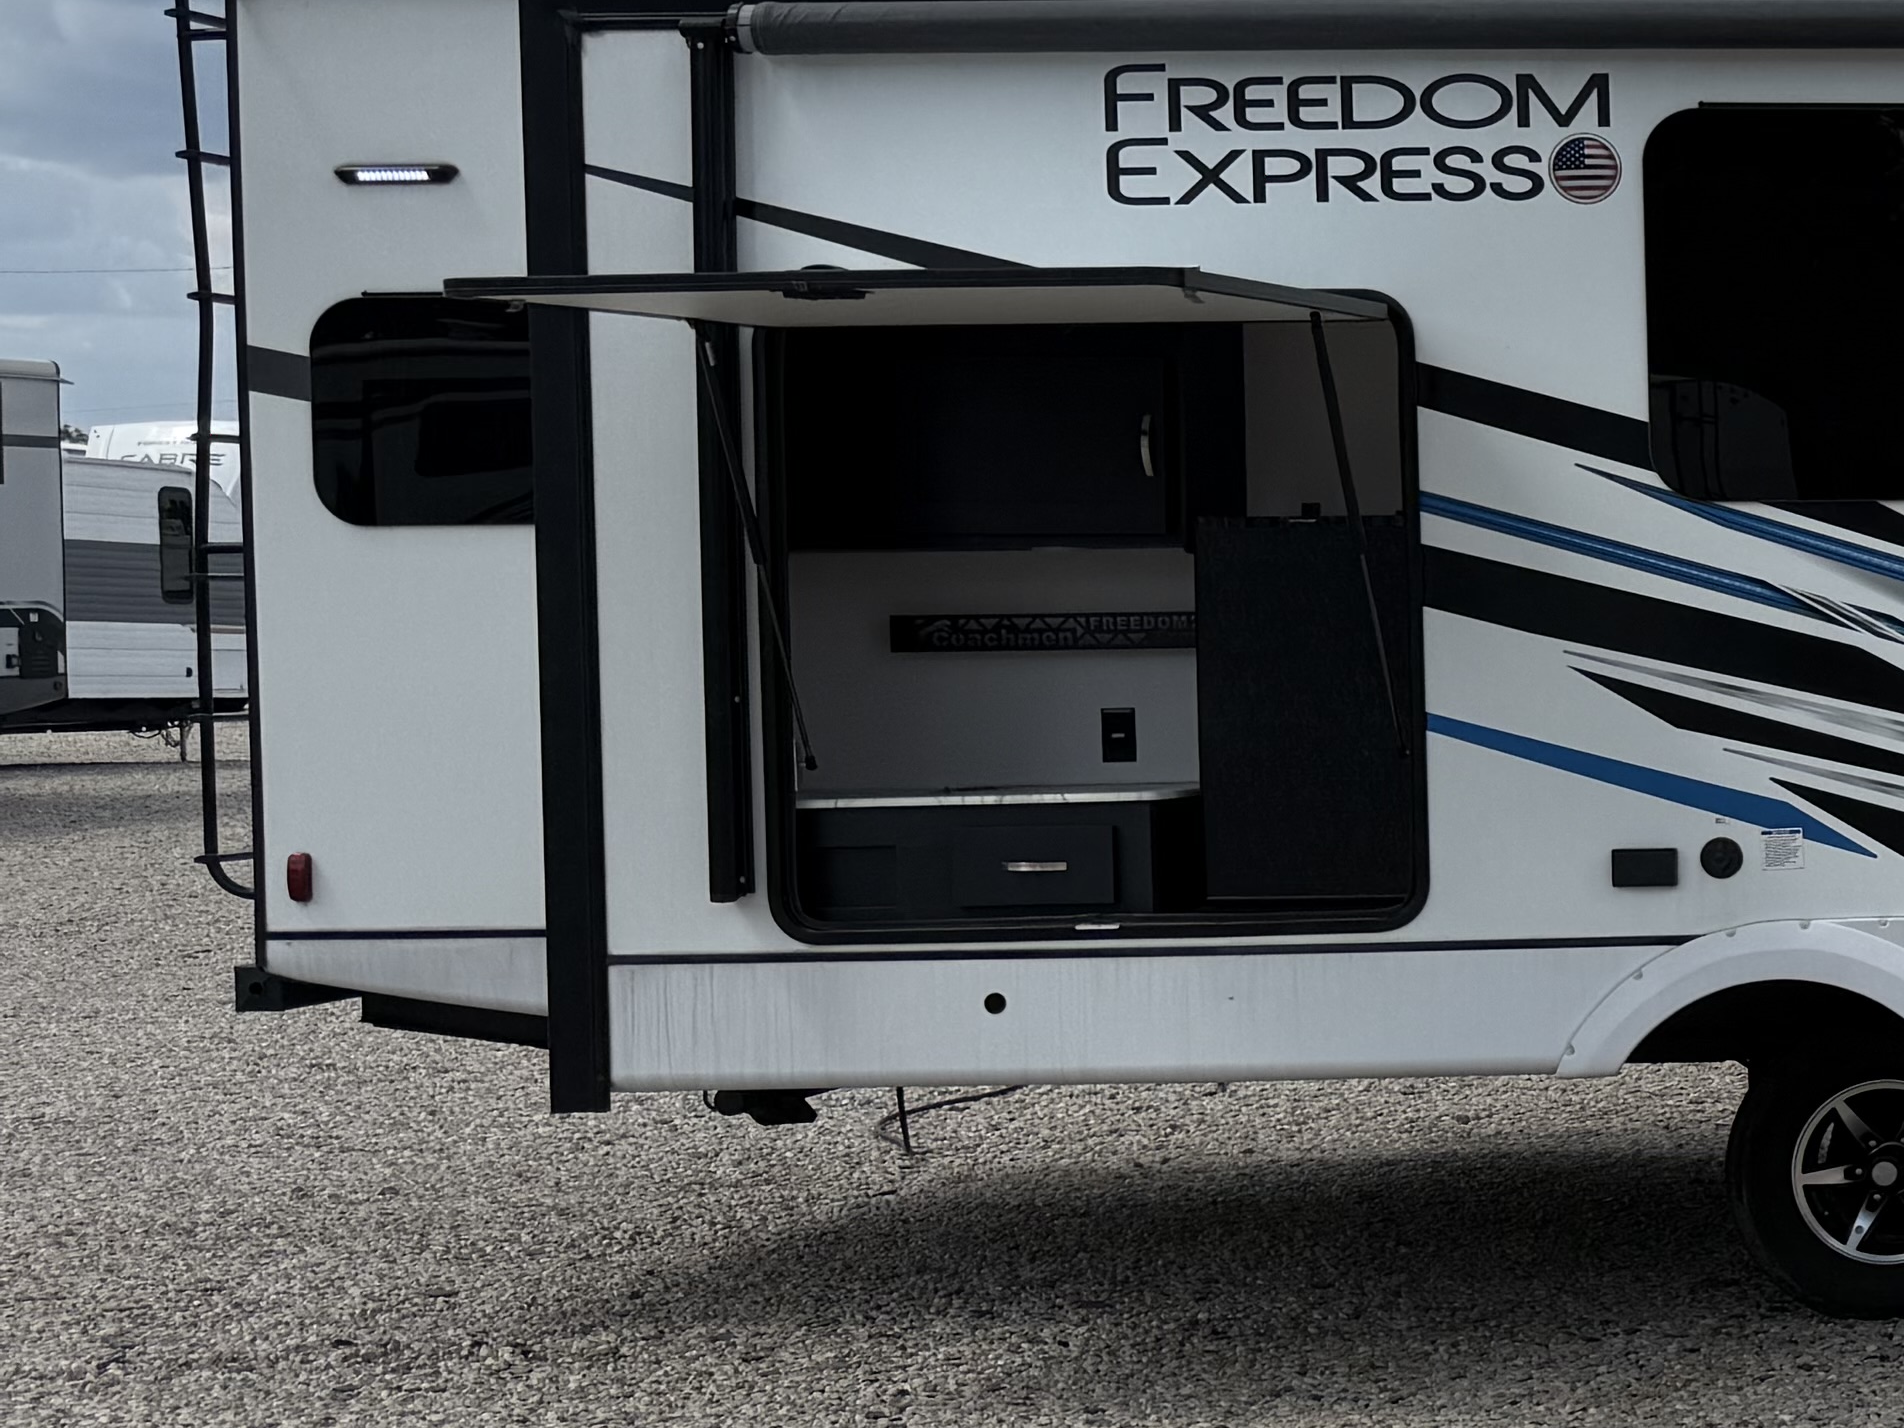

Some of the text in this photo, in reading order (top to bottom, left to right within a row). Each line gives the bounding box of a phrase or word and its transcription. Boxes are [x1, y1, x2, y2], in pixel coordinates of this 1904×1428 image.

[1104, 63, 1612, 133] FREEDOM
[1105, 137, 1546, 206] EXPRESS
[931, 628, 1075, 648] Coachmen
[1088, 615, 1188, 631] FREEDOM
